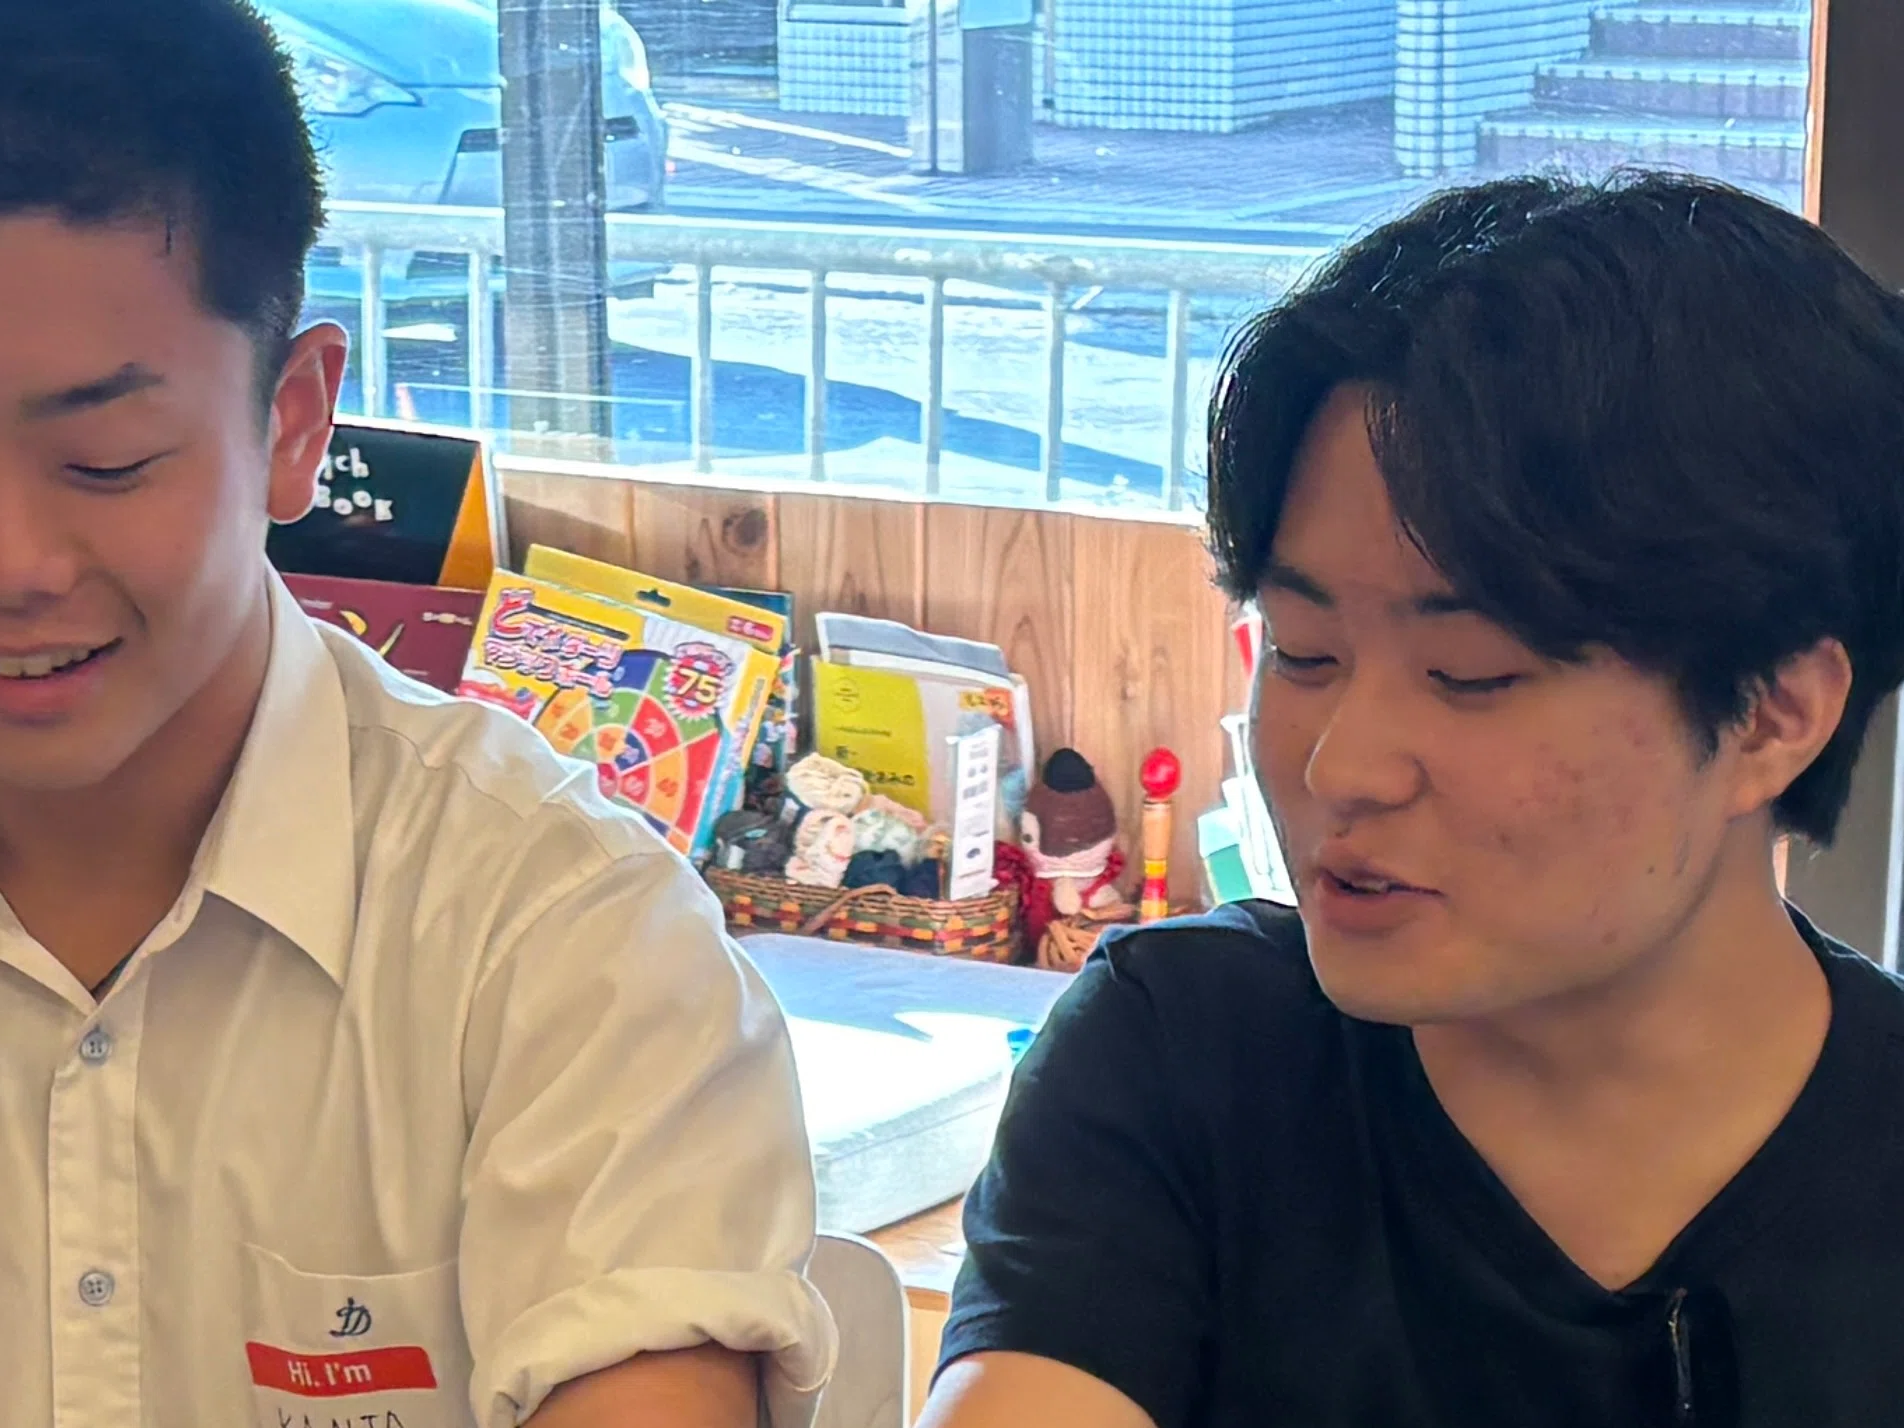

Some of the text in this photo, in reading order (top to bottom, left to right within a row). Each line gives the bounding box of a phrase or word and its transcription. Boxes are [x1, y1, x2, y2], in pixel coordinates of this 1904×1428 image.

[677, 667, 718, 704] 75
[288, 1361, 372, 1388] Hi. I'm
